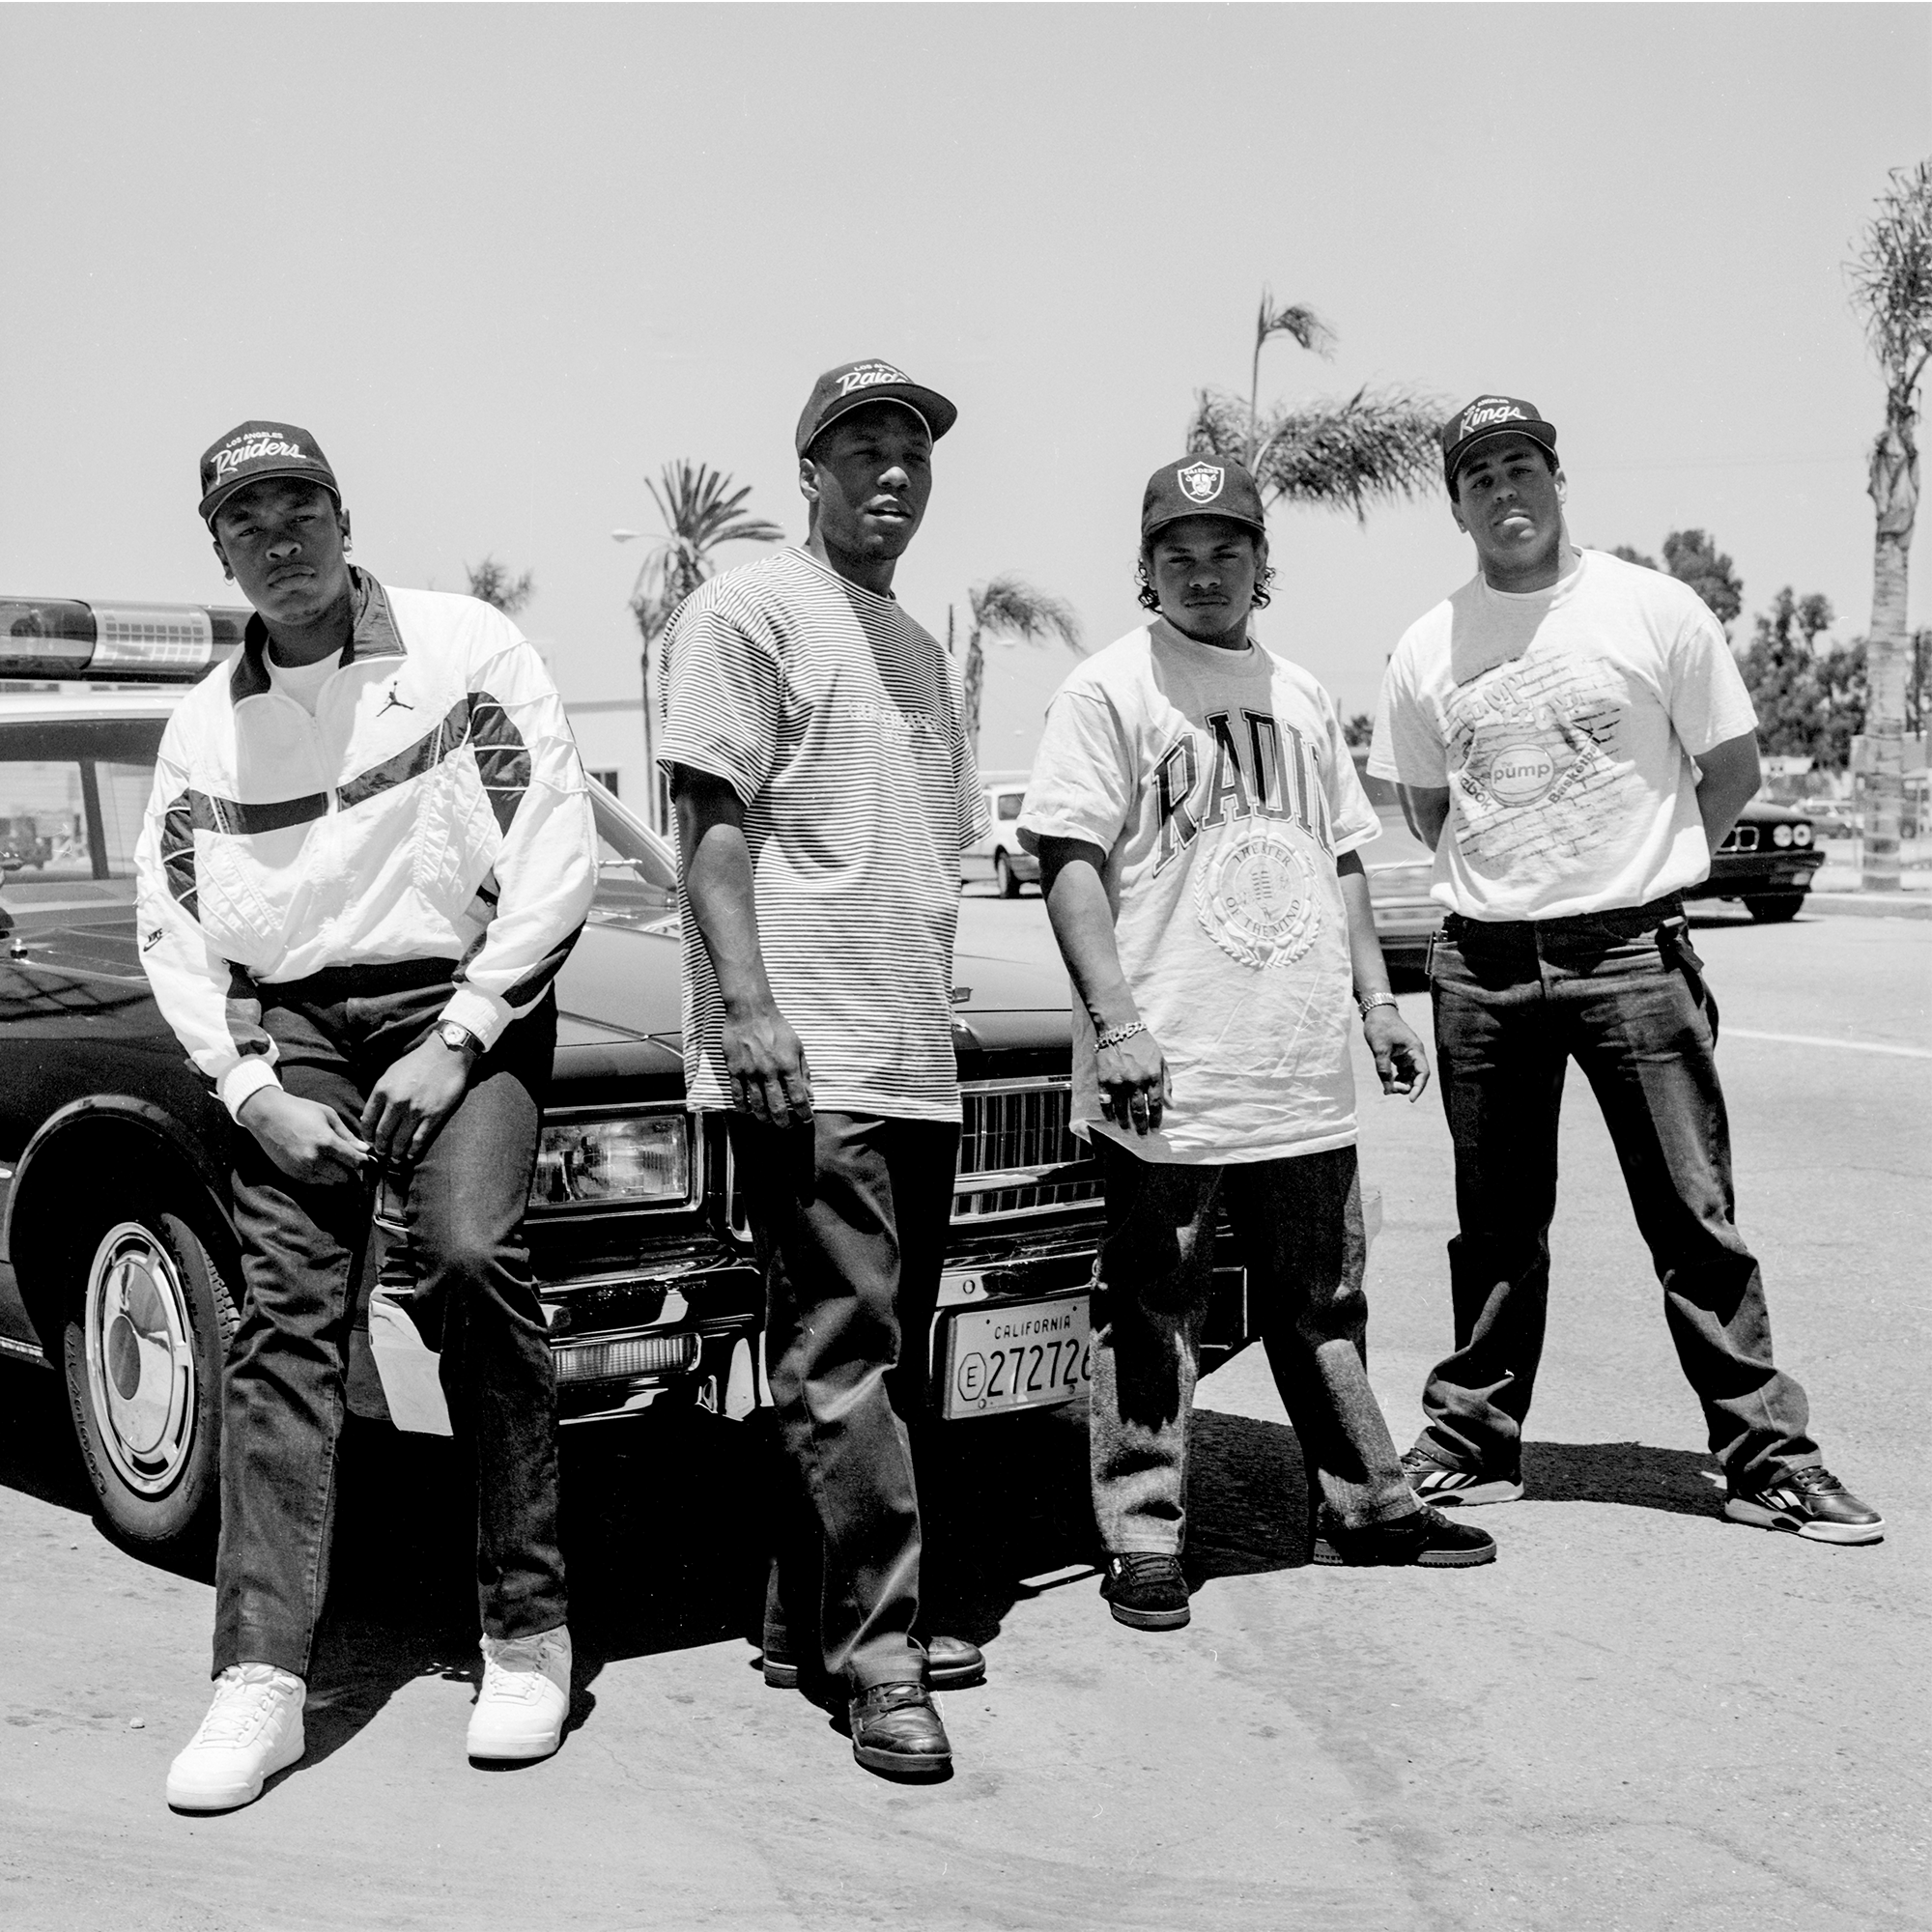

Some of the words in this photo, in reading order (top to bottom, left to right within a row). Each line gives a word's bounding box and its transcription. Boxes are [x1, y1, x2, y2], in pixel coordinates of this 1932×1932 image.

[836, 367, 907, 397] Raid
[1459, 406, 1527, 441] Kings
[226, 436, 242, 448] LOS
[243, 432, 283, 440] ANGELES
[210, 438, 307, 486] Raiders
[1493, 763, 1551, 784] pump
[1233, 843, 1292, 867] THEATER
[1226, 896, 1243, 916] OF
[1244, 917, 1270, 937] THE
[1270, 899, 1301, 933] MIND
[994, 1315, 1071, 1340] CALIFORNIA
[967, 1365, 978, 1388] E
